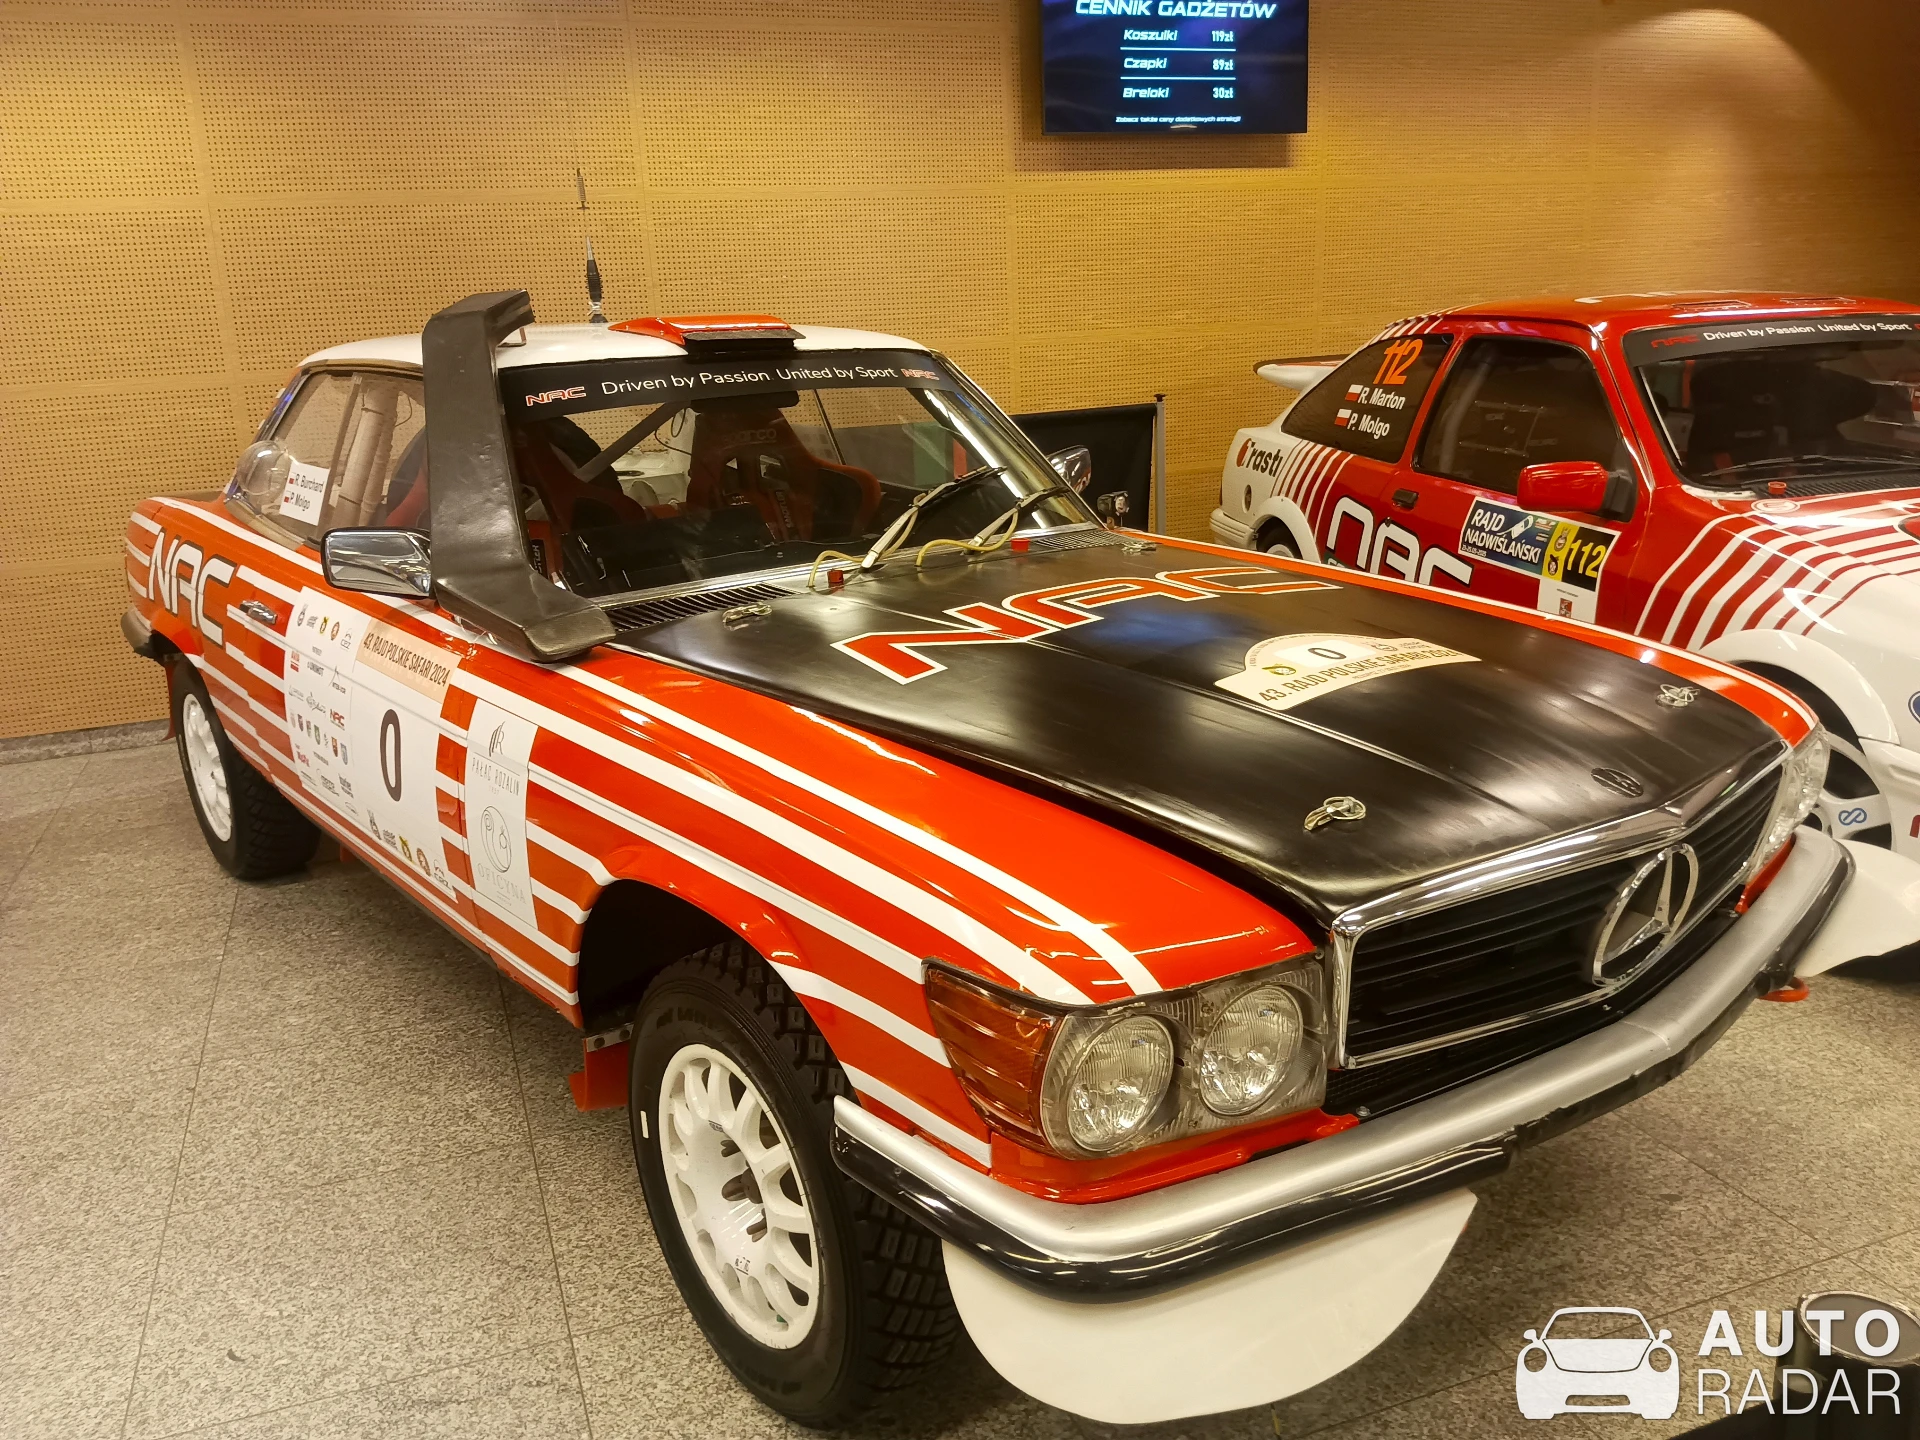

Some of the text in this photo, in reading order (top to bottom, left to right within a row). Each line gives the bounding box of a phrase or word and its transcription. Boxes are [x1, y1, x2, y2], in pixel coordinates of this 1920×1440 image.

[1075, 0, 1277, 19] CENNIK GADŻETÓW
[1123, 29, 1178, 41] Koszulki
[1211, 30, 1234, 42] 119zł
[1123, 57, 1168, 70] Czapki
[1212, 58, 1234, 71] 89zł
[1122, 87, 1170, 98] Breloki
[1212, 87, 1234, 99] 30zł
[1703, 330, 1748, 341] Driven
[1746, 328, 1764, 337] by
[1765, 324, 1816, 335] Passion
[1817, 322, 1860, 332] United
[1859, 322, 1877, 332] by
[1876, 322, 1913, 332] Sport
[1372, 338, 1423, 385] 112
[525, 385, 587, 407] NAC
[601, 378, 668, 396] Driven
[670, 374, 695, 389] by
[776, 367, 833, 381] United
[833, 366, 854, 380] by
[855, 366, 899, 380] Sport
[901, 368, 940, 381] NAC
[1358, 386, 1406, 410] R. Marton
[1347, 412, 1390, 440] P. Molgo
[1470, 508, 1505, 532] RAJD
[1464, 527, 1542, 564] NADWIŚLAŃSKI
[1566, 539, 1607, 579] 112
[147, 525, 237, 648] NAC
[828, 566, 1344, 686] NAC
[363, 632, 451, 687] 43. RAJD POLSKIE SAFARI 2024
[1307, 647, 1347, 660] 0
[1258, 688, 1293, 702] 43.
[1281, 673, 1329, 692] RAJD
[1318, 658, 1386, 679] POLSKIE
[379, 708, 402, 803] 0
